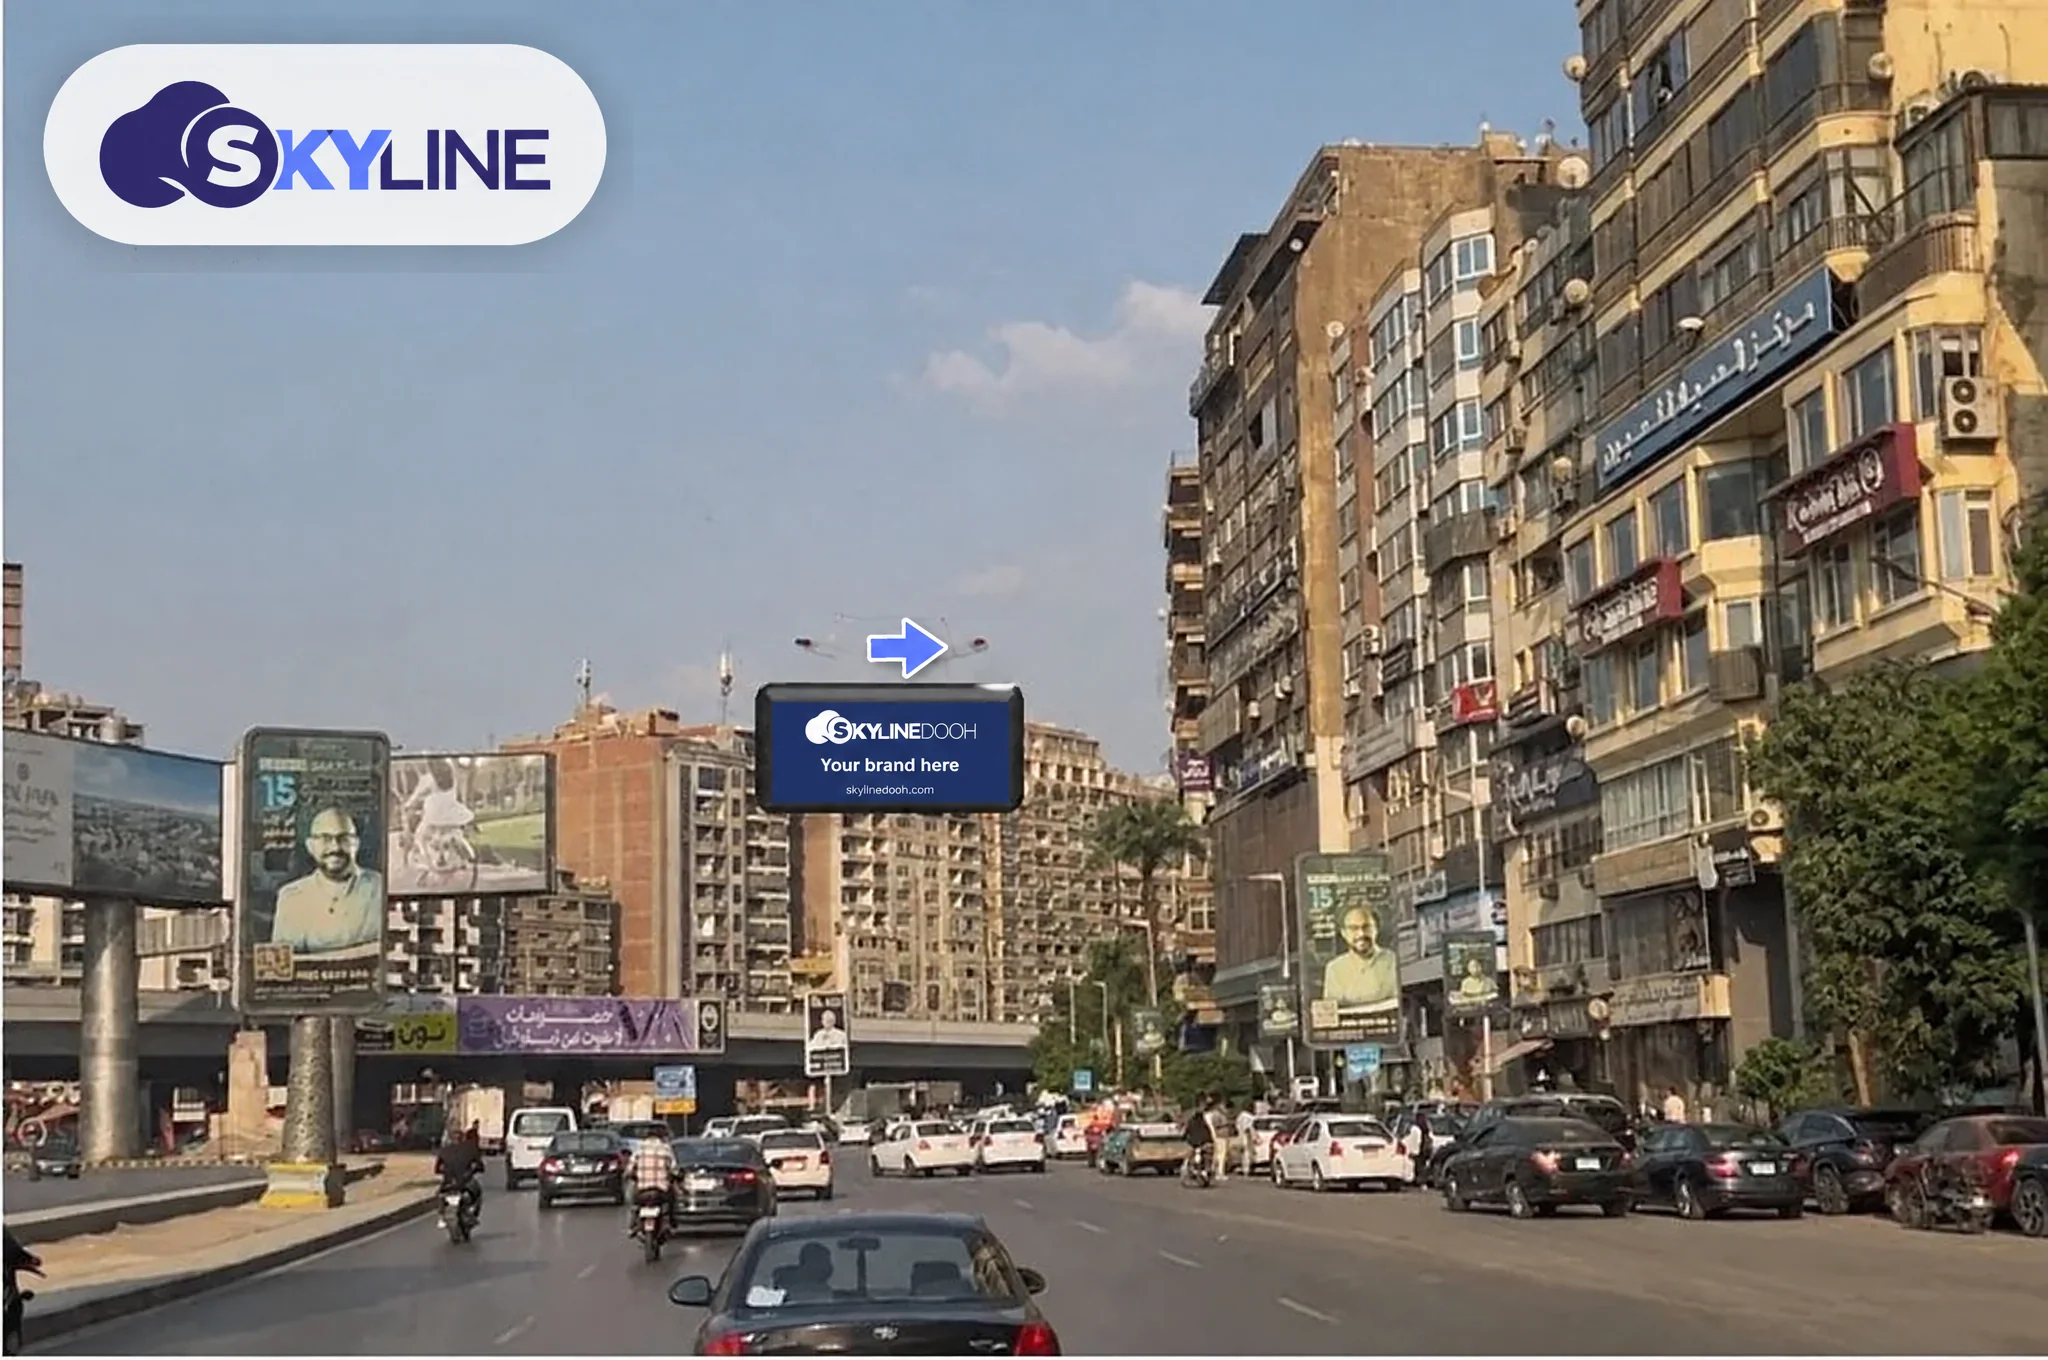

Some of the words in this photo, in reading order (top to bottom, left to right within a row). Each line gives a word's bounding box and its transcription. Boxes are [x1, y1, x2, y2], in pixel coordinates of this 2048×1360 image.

[1748, 302, 1815, 371] مركز
[832, 722, 977, 740] SKYLINEDOOH
[820, 758, 860, 772] Your
[865, 757, 915, 772] brand
[921, 758, 960, 772] here
[260, 774, 297, 807] 15
[846, 784, 935, 796] skylinedooh.com
[1308, 887, 1333, 908] 15
